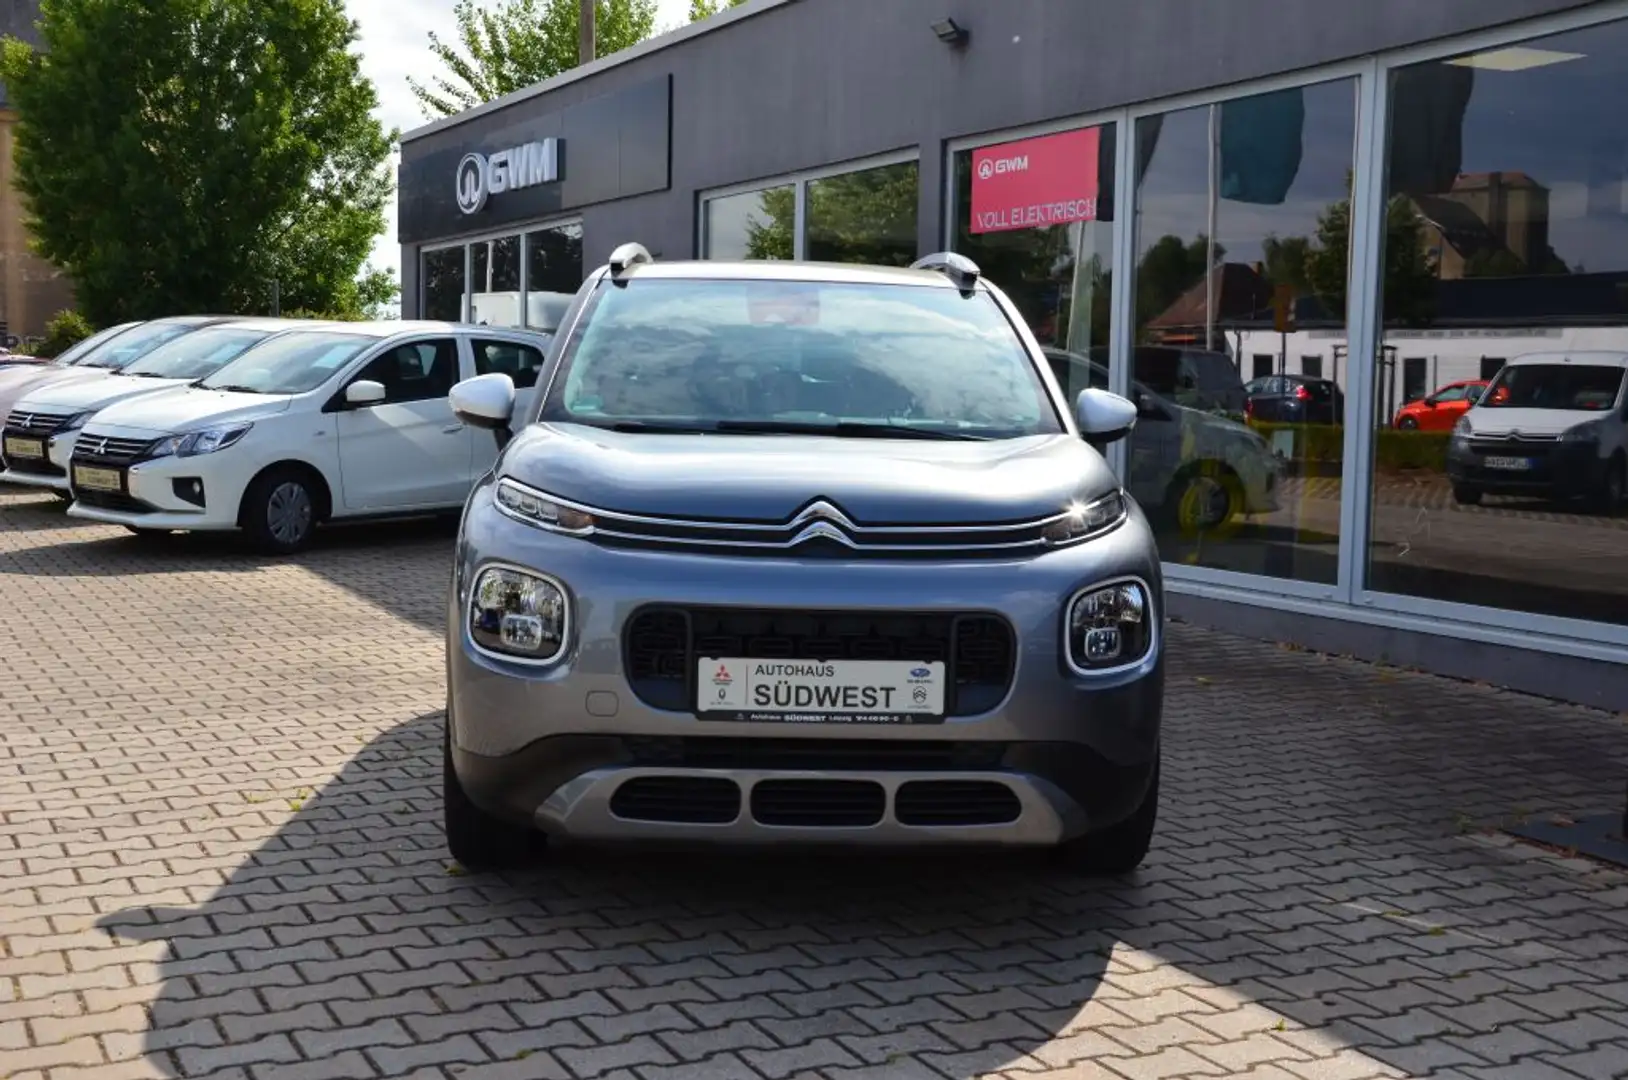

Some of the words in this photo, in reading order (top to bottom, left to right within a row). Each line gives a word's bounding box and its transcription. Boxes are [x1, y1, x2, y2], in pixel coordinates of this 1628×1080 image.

[487, 137, 558, 194] GWM
[995, 155, 1028, 173] GWM
[976, 209, 1008, 228] VOLL
[754, 664, 835, 678] AUTOHAUS
[753, 680, 896, 708] SÜDWEST
